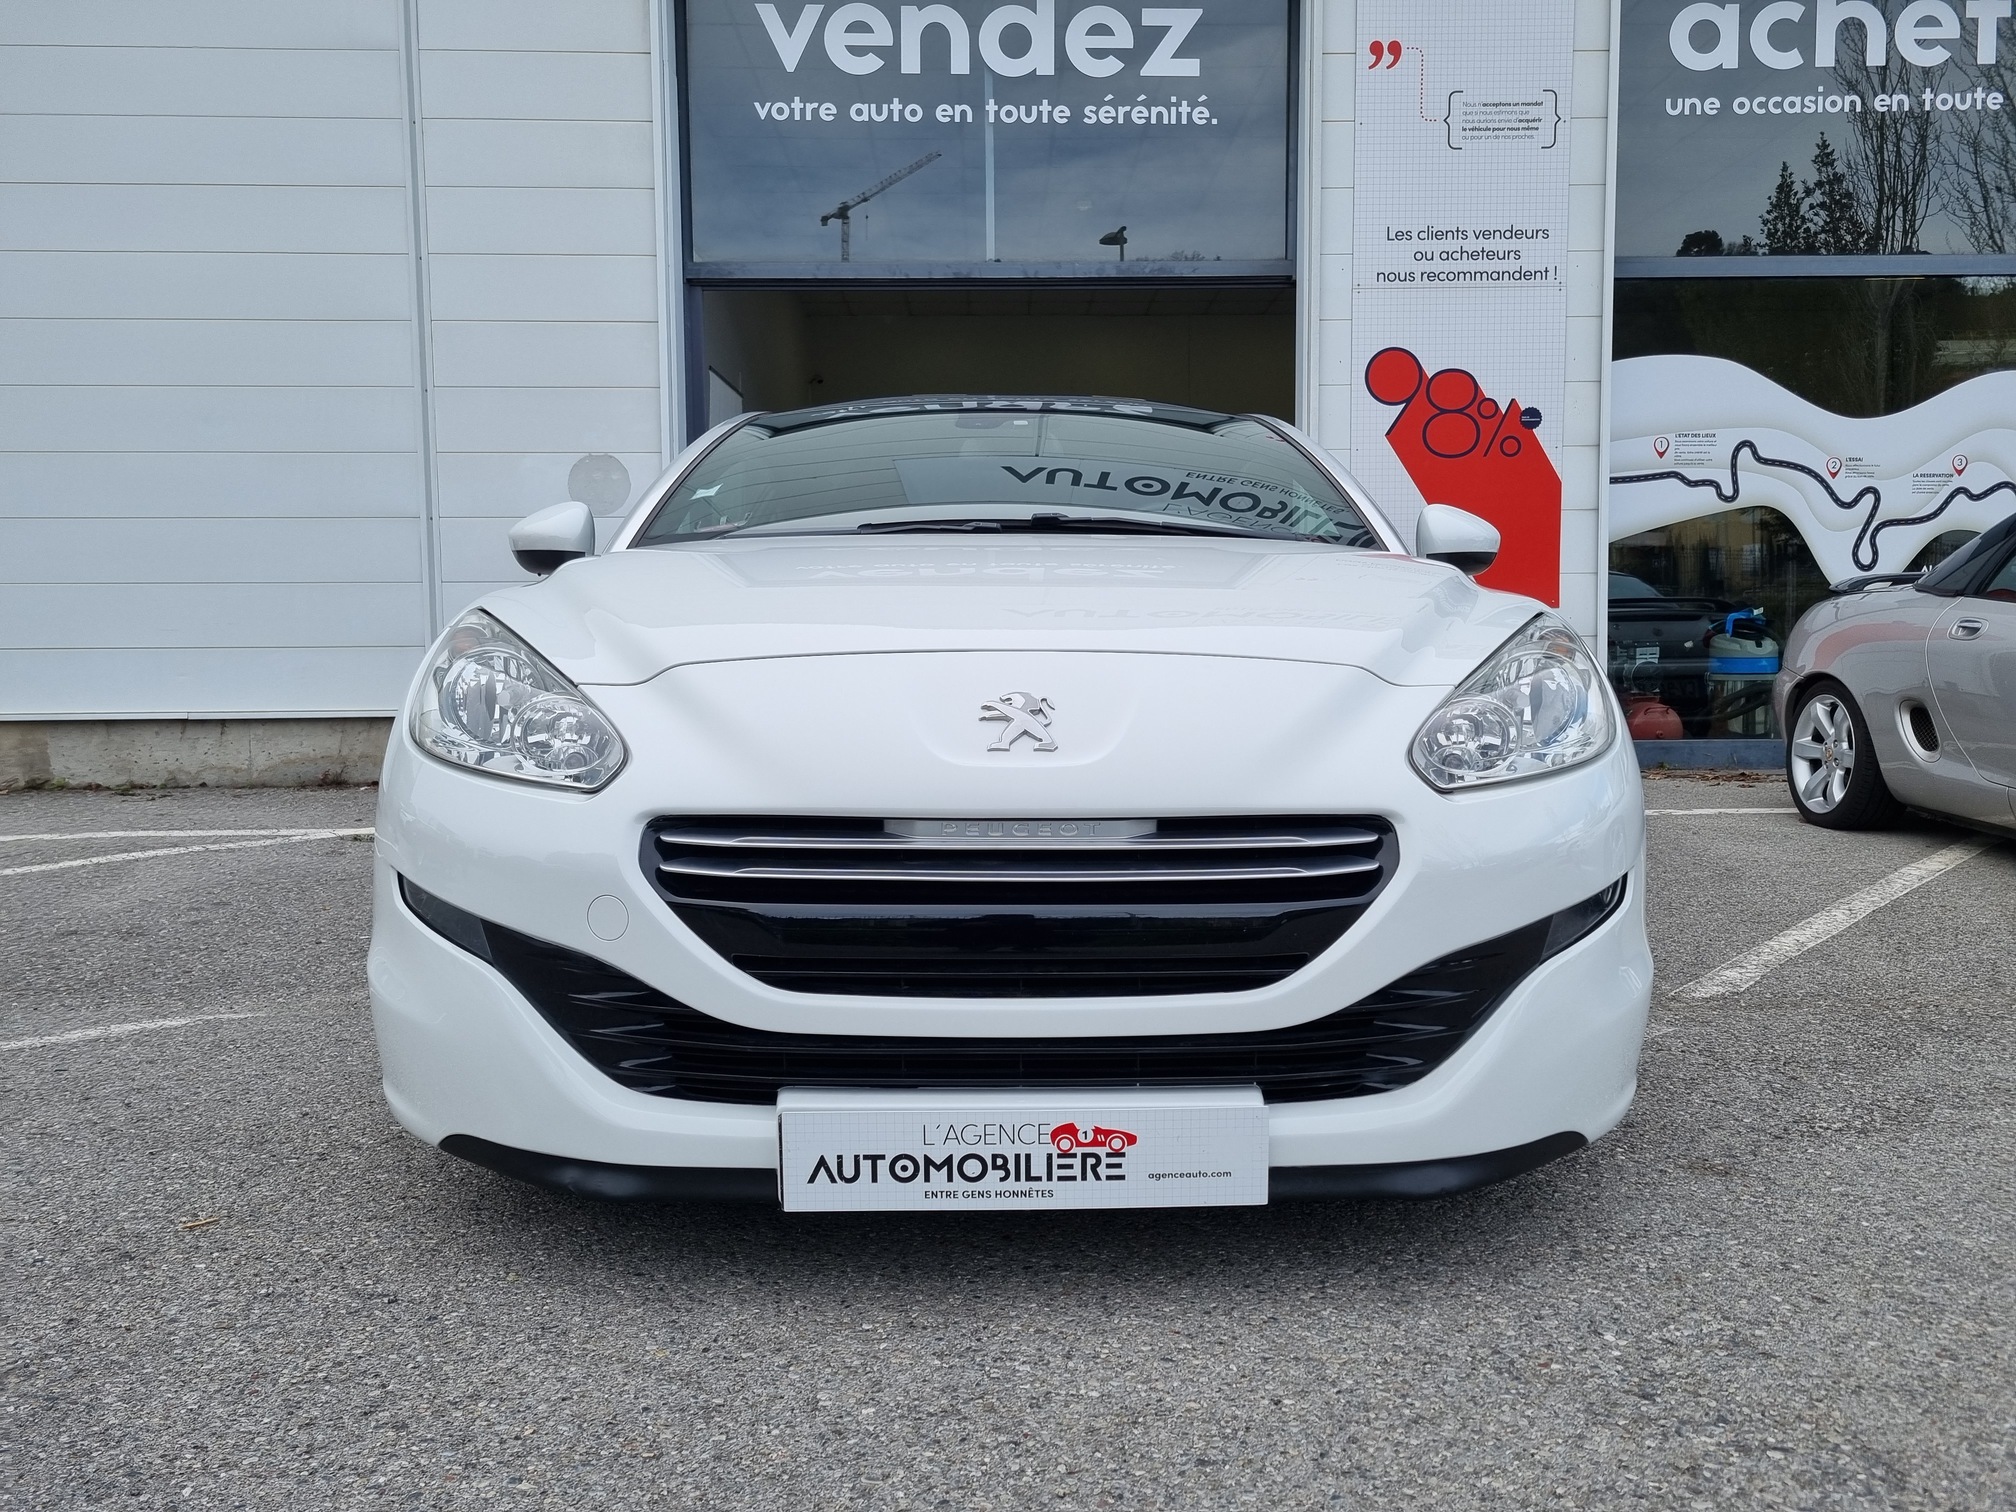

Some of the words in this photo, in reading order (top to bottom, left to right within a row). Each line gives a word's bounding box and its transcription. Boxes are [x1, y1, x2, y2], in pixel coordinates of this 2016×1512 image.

[754, 0, 1204, 77] vendez
[1669, 0, 2011, 70] achet
[753, 97, 837, 123] votre
[849, 97, 923, 124] auto
[935, 102, 973, 124] en
[985, 98, 1070, 125] toute
[1083, 94, 1218, 125] sérénité.
[1666, 95, 1721, 116] une
[1732, 86, 1862, 115] occasion
[1874, 92, 1909, 113] en
[1922, 87, 2004, 111] toute
[1386, 226, 1413, 241] Les
[1417, 225, 1469, 241] clients
[1472, 224, 1550, 240] vendeurs
[1413, 250, 1434, 262] ou
[1439, 245, 1521, 261] acheteurs
[1376, 271, 1416, 282] nous
[1420, 265, 1550, 282] recommandent
[1364, 346, 1522, 459] 98%
[1831, 461, 1837, 469] 2
[1957, 458, 1963, 466] 3
[940, 822, 1102, 837] PEUGEOT
[922, 1123, 1051, 1145] L'AGENCE
[1147, 1170, 1232, 1181] agenceauto.com
[924, 1190, 959, 1199] ENTRE
[961, 1189, 992, 1199] GENS
[994, 1186, 1054, 1199] HONNÊTES
